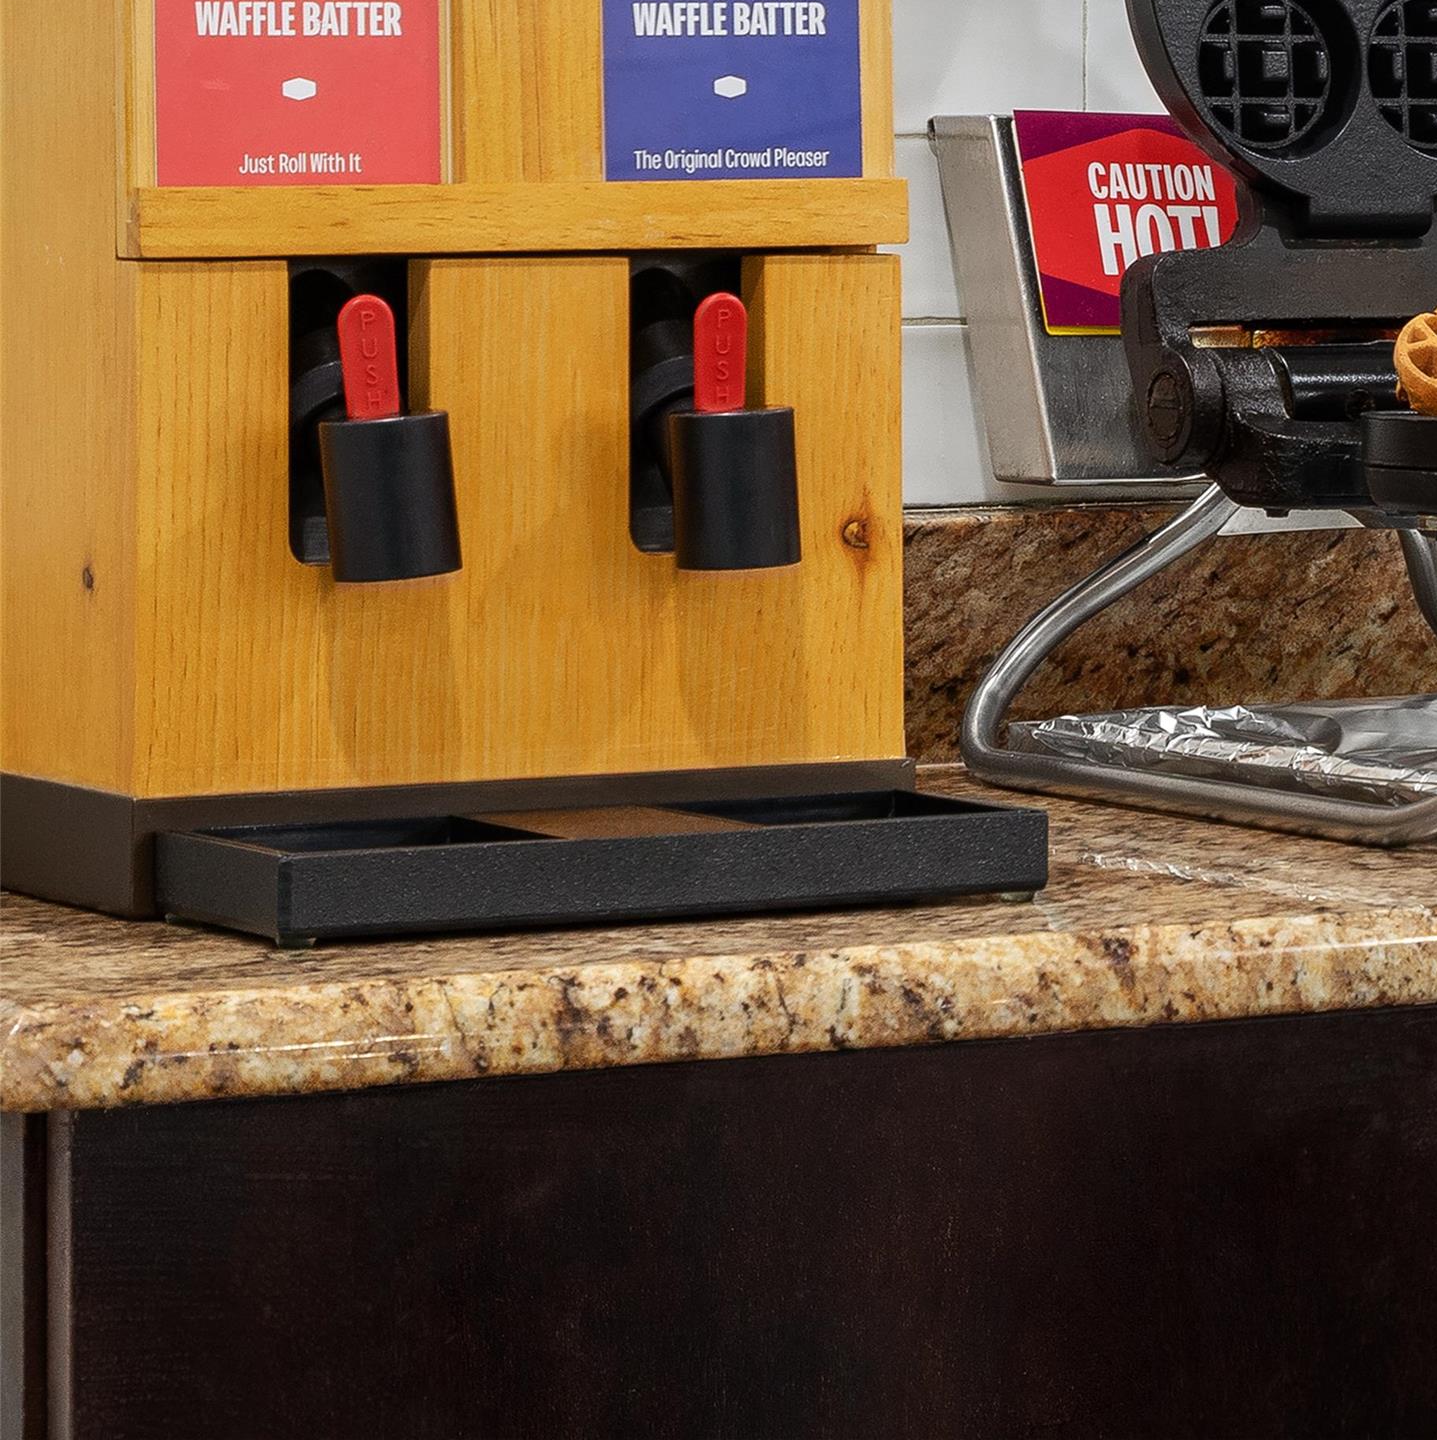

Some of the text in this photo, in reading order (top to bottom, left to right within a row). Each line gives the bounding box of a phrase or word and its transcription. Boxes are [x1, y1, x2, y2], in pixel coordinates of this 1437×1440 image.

[195, 0, 402, 37] WAFFLE BATTER
[633, 1, 826, 37] WAFFLE BATTER
[239, 150, 361, 175] Just Roll With It
[633, 147, 829, 172] The Original Crowd Pleaser
[1087, 162, 1216, 201] CAUTION
[360, 310, 383, 411] PUSH
[715, 309, 731, 404] PUSH
